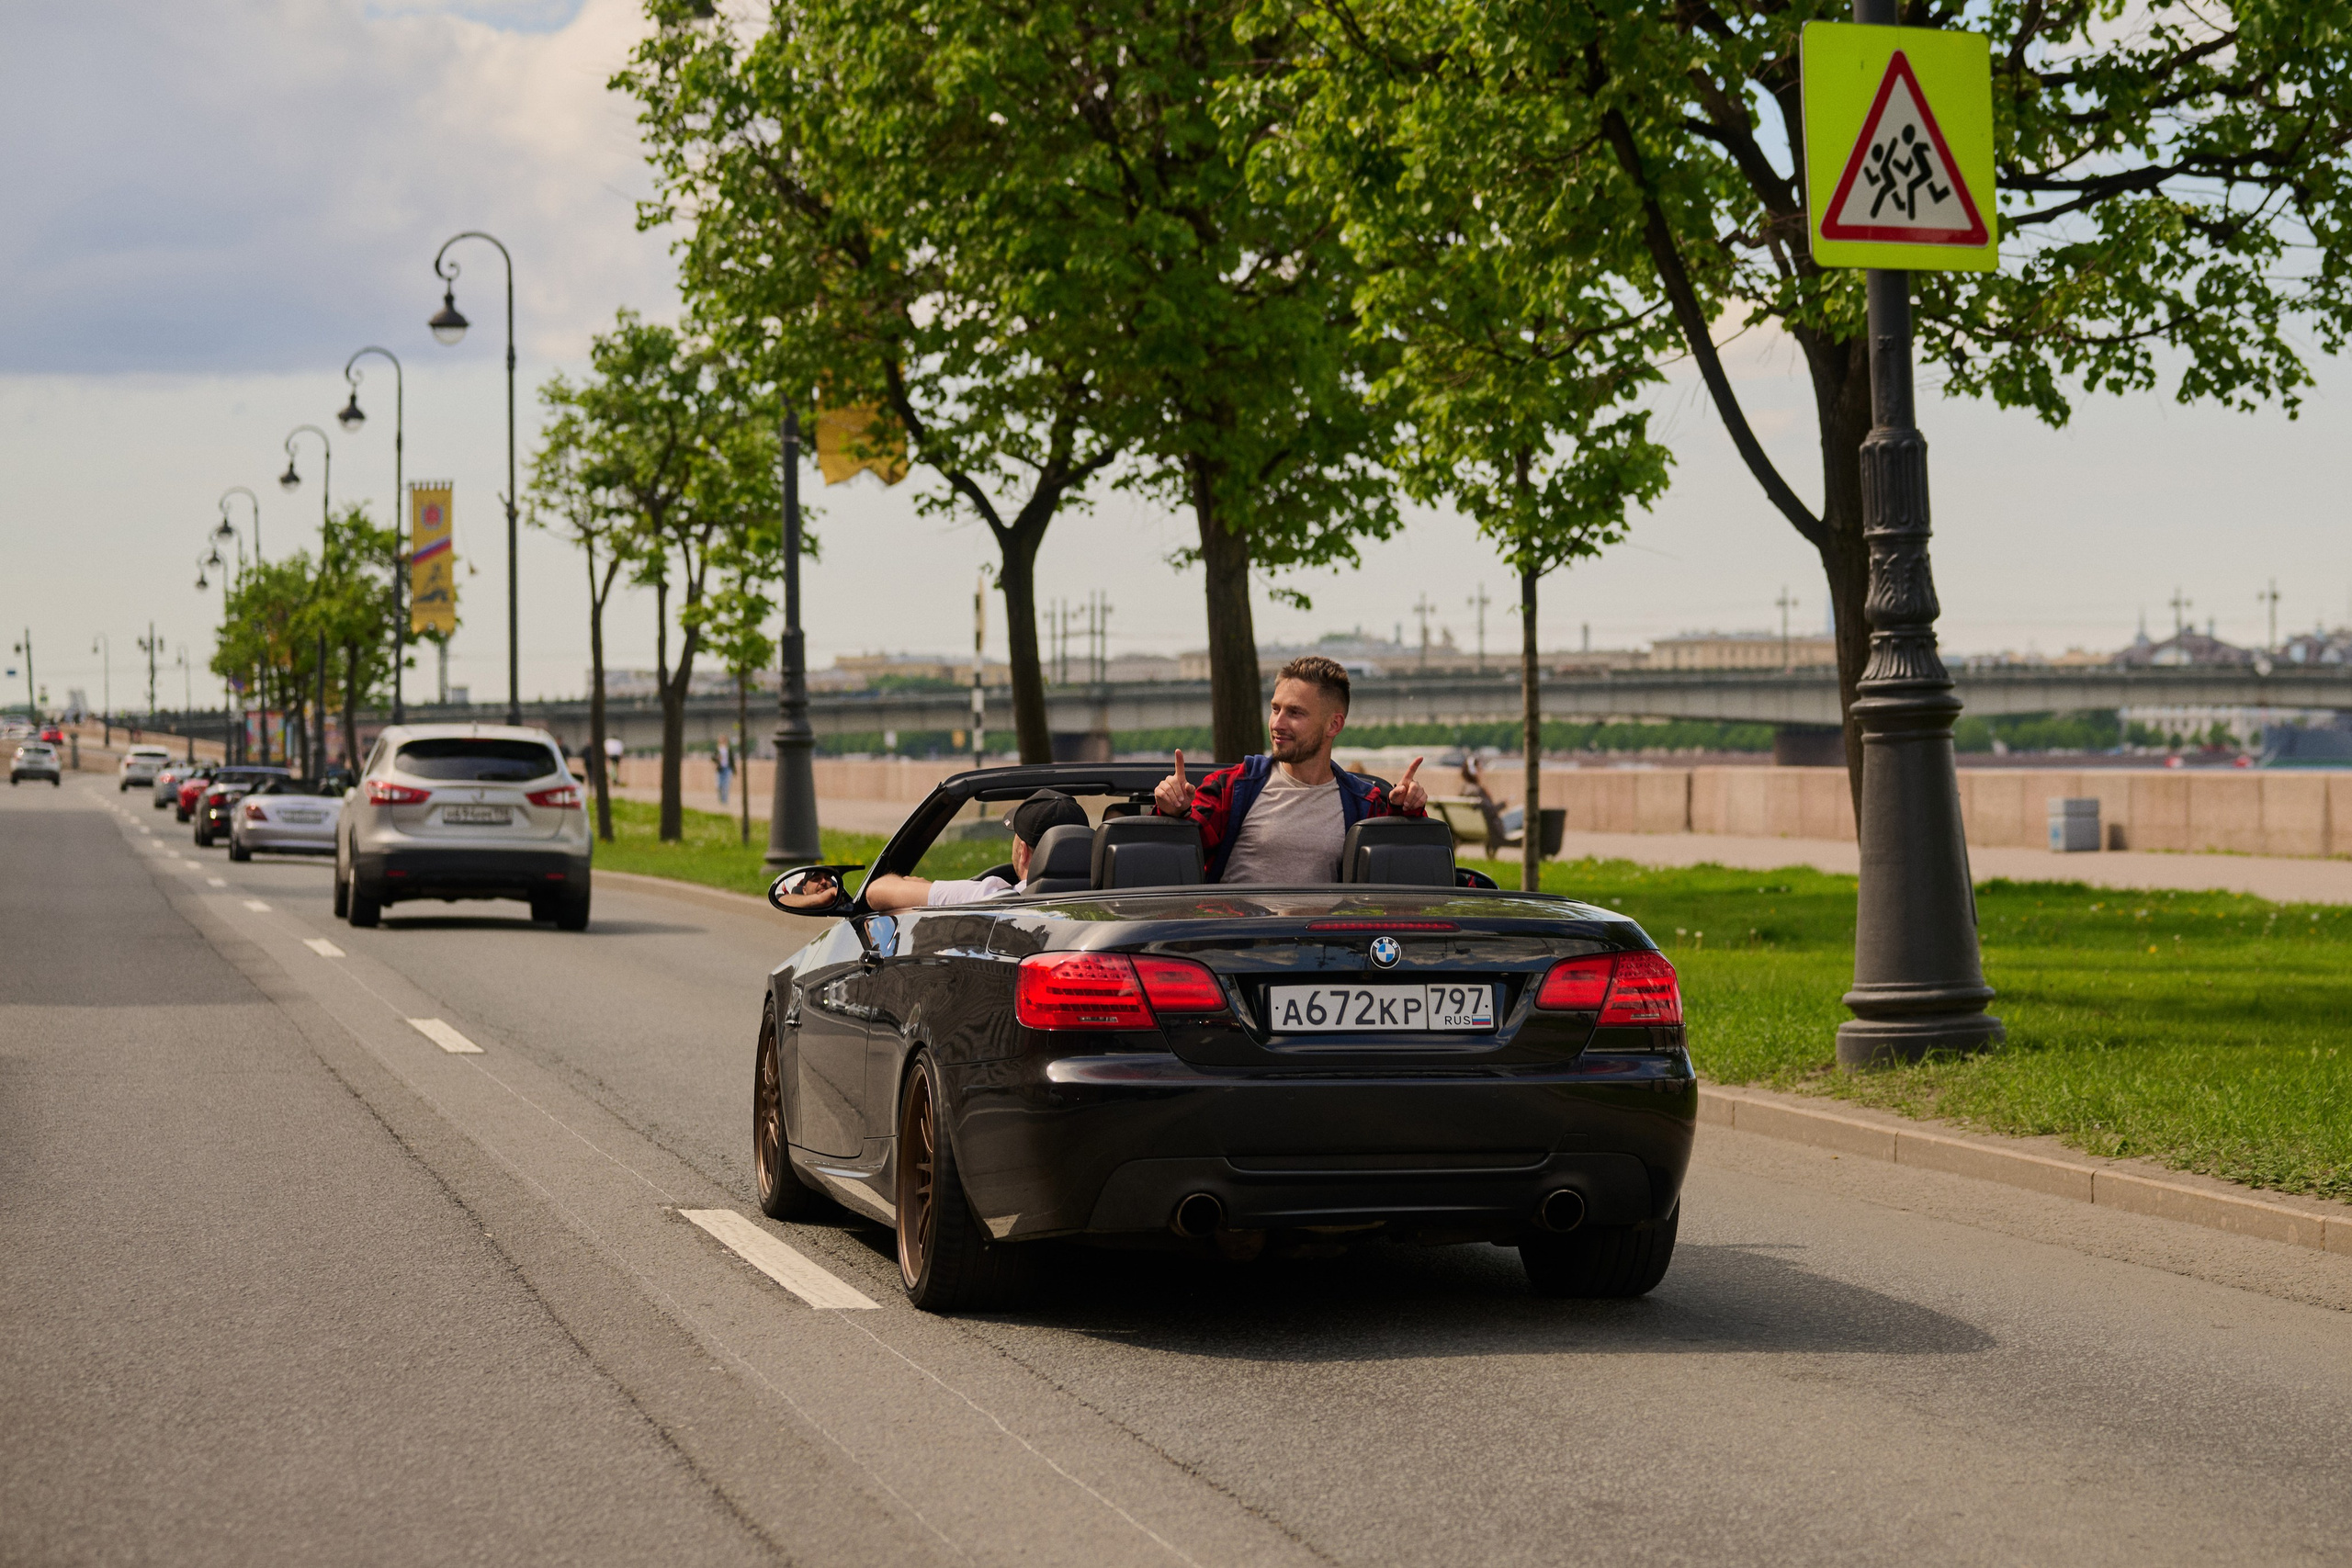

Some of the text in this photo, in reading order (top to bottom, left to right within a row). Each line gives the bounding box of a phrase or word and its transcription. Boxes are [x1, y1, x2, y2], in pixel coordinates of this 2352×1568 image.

[1374, 938, 1398, 949] BMW
[1430, 987, 1484, 1015] 797
[1444, 1015, 1471, 1025] RUS
